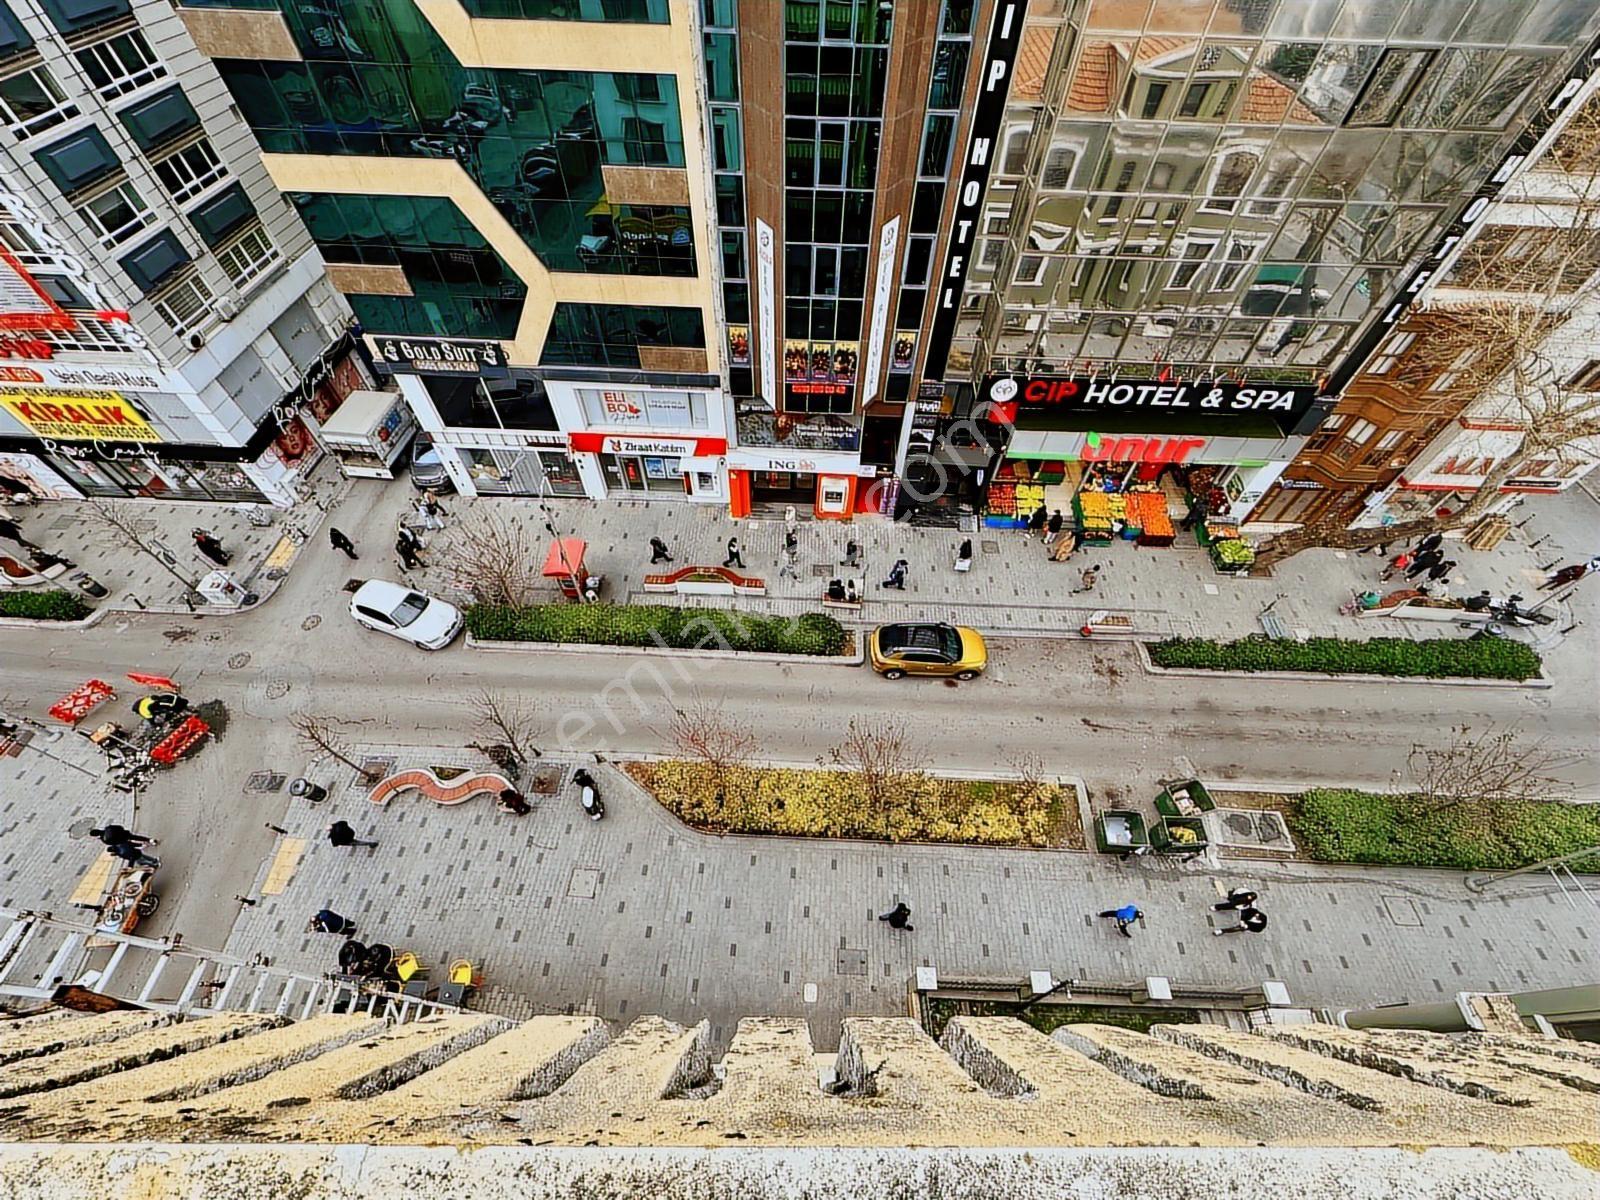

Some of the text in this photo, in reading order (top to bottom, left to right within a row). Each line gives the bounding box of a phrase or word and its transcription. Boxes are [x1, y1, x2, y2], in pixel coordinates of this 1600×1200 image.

[943, 137, 990, 309] HOTEL
[400, 341, 477, 362] GOLD SUIT
[118, 372, 159, 388] Kurs
[1084, 382, 1191, 408] HOTEL
[1200, 386, 1224, 409] &
[1230, 388, 1296, 411] SPA
[10, 397, 139, 426] KİRALIK
[623, 441, 653, 452] Ziraat
[767, 459, 796, 471] ING
